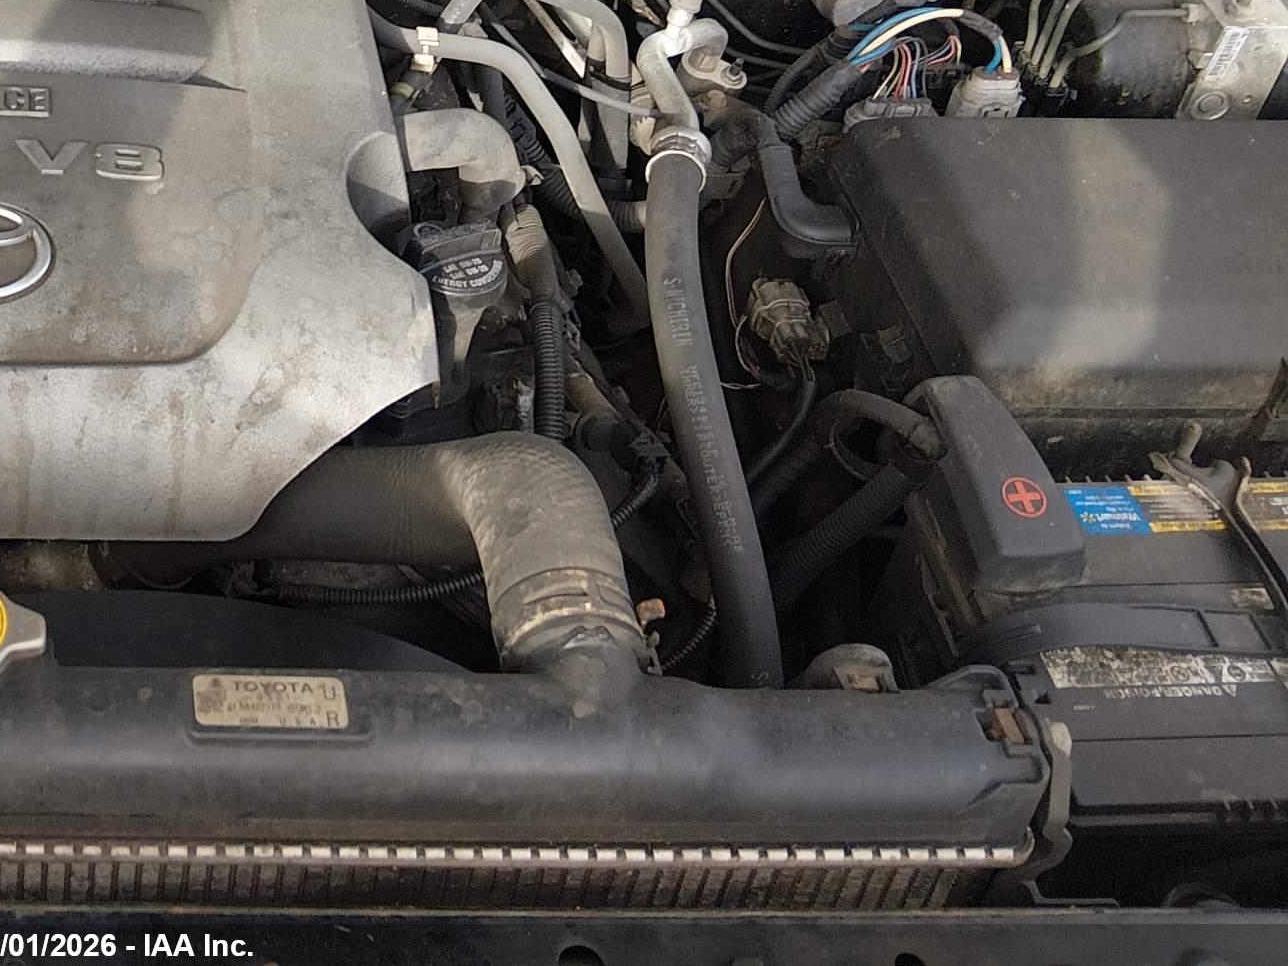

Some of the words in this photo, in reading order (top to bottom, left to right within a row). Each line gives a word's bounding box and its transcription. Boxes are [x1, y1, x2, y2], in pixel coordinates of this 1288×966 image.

[16, 138, 164, 181] V8
[432, 275, 468, 288] ENERGY
[233, 681, 314, 694] TOYOTA
[322, 683, 337, 701] U
[326, 710, 340, 727] R
